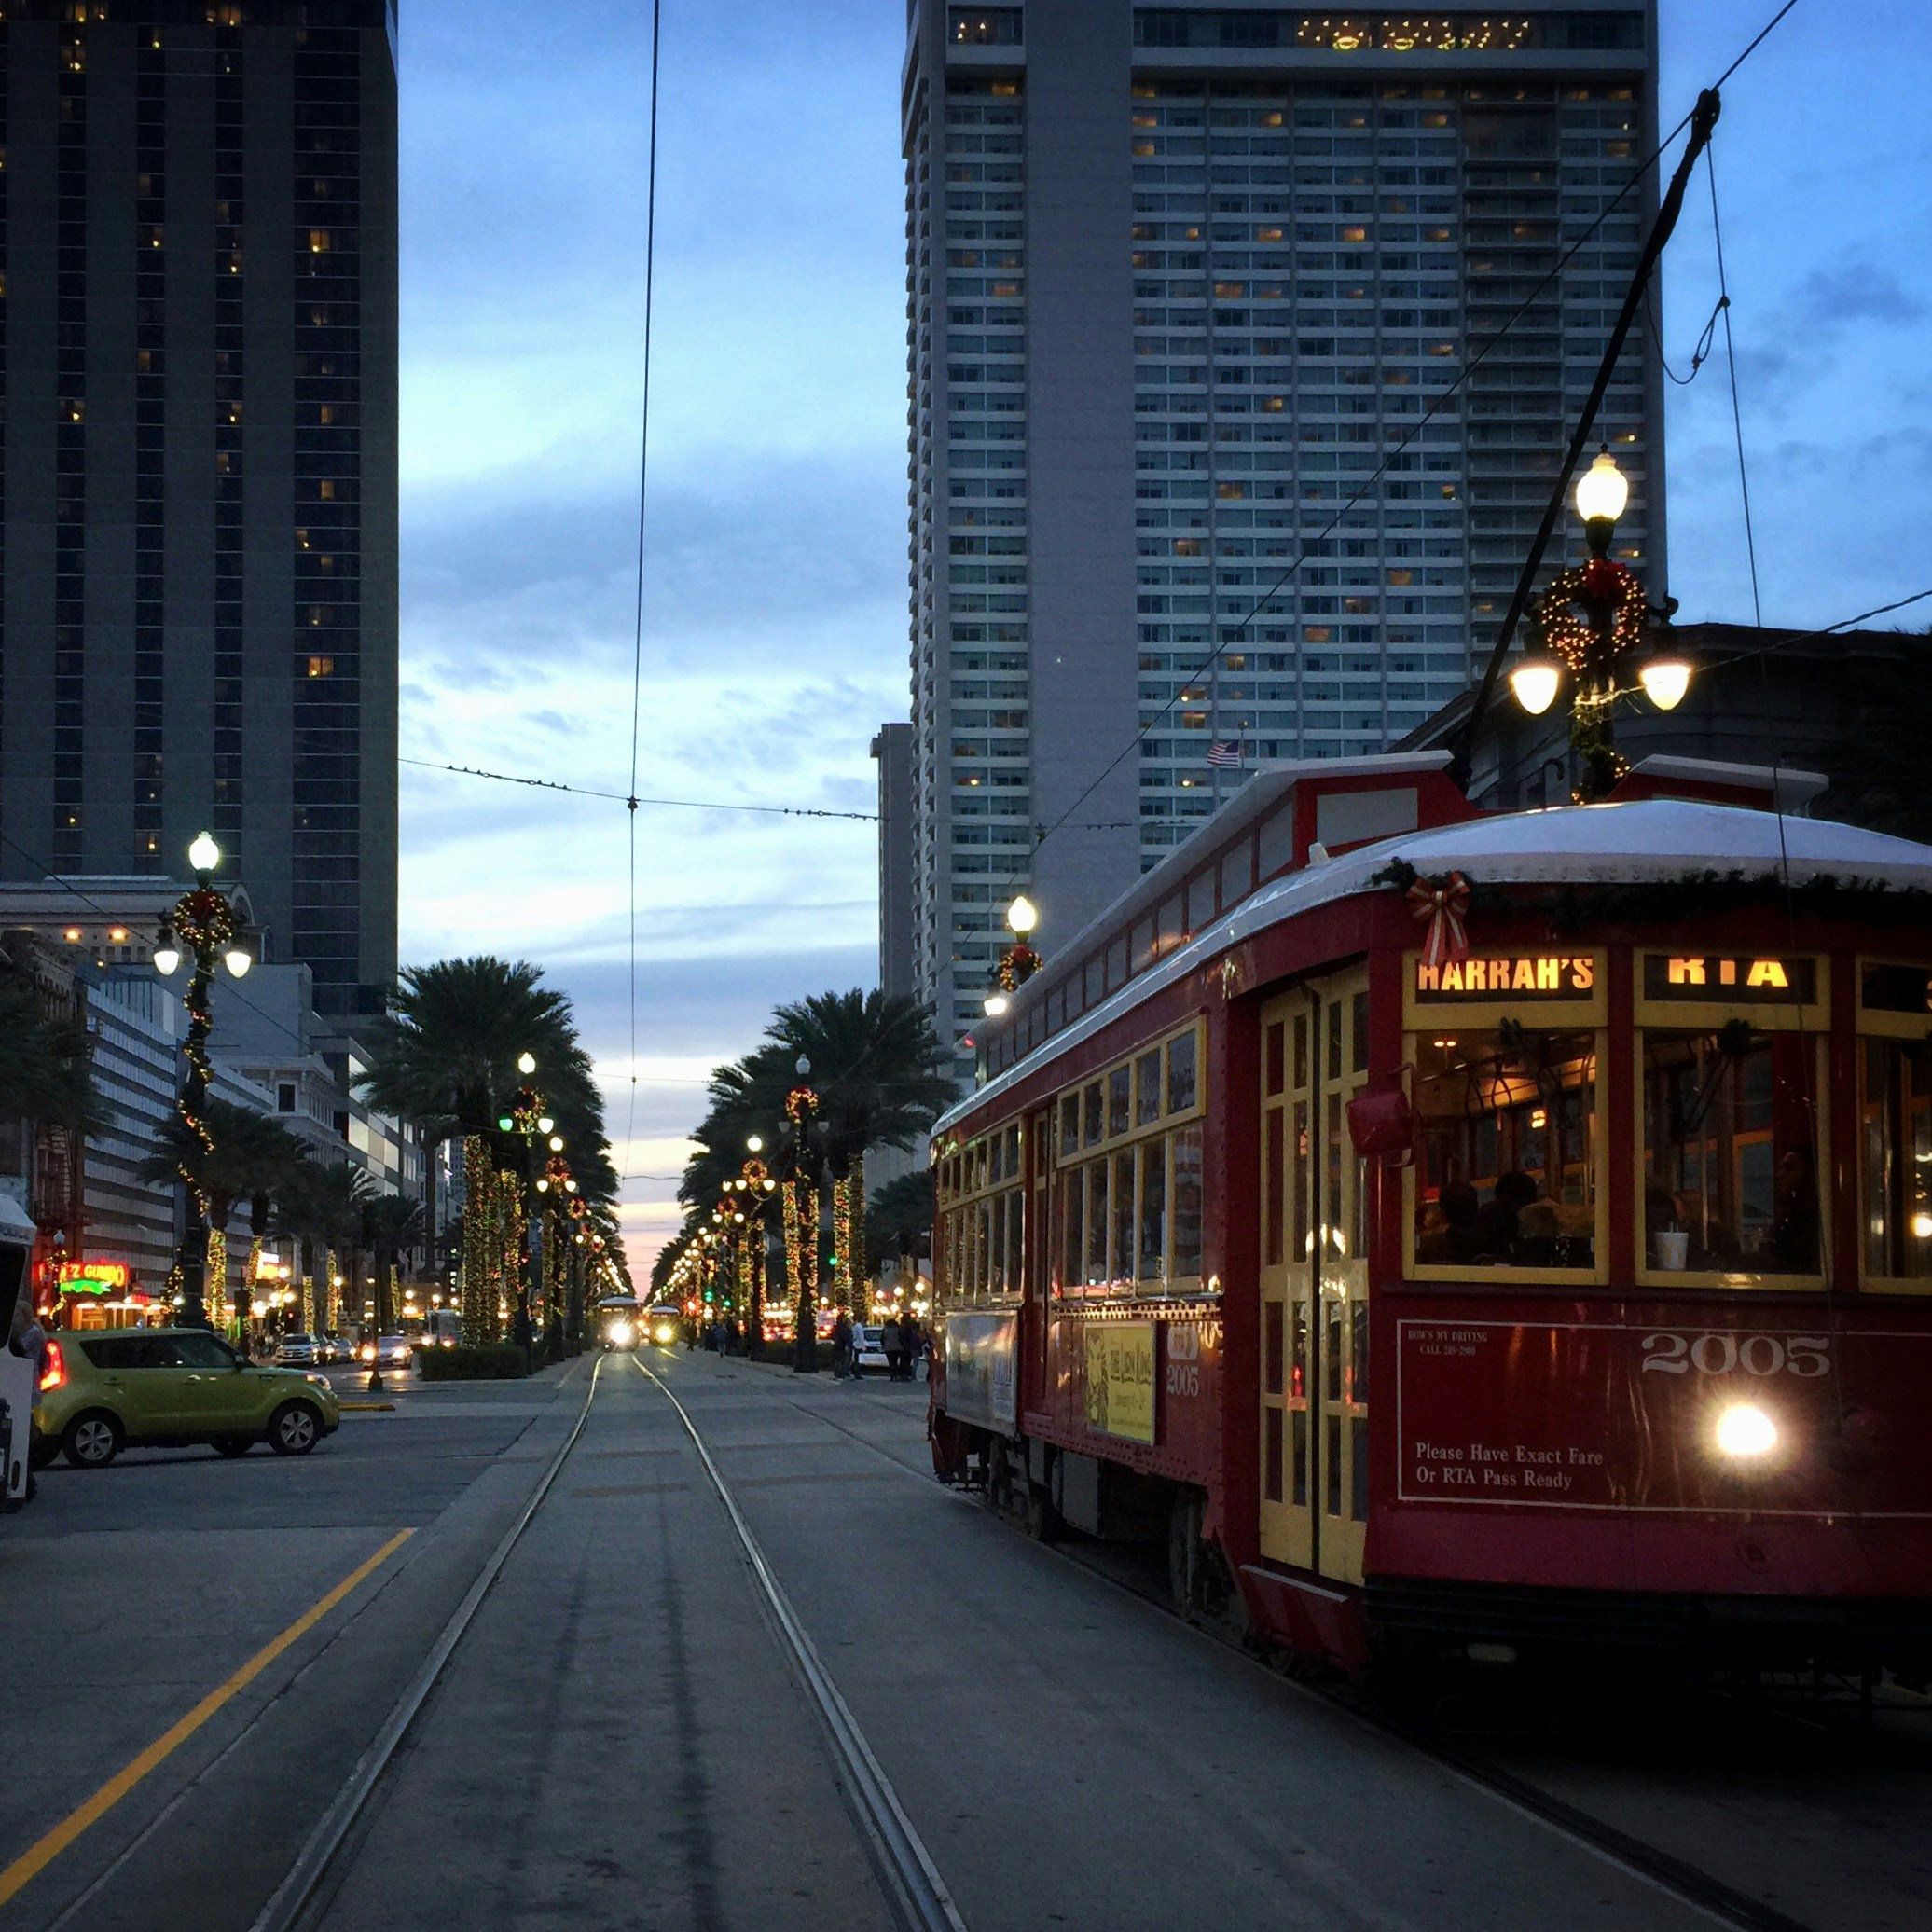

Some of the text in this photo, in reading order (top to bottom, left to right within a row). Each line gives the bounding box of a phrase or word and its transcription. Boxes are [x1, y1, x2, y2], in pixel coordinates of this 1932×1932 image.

[1418, 958, 1593, 990] HARRAH'S
[1419, 1345, 1442, 1355] CALL
[1641, 1333, 1830, 1377] 2005
[1166, 1364, 1199, 1397] 2005
[1416, 1442, 1603, 1465] Please Have Exact Fare
[1416, 1466, 1572, 1490] Or RTA Pass Ready
